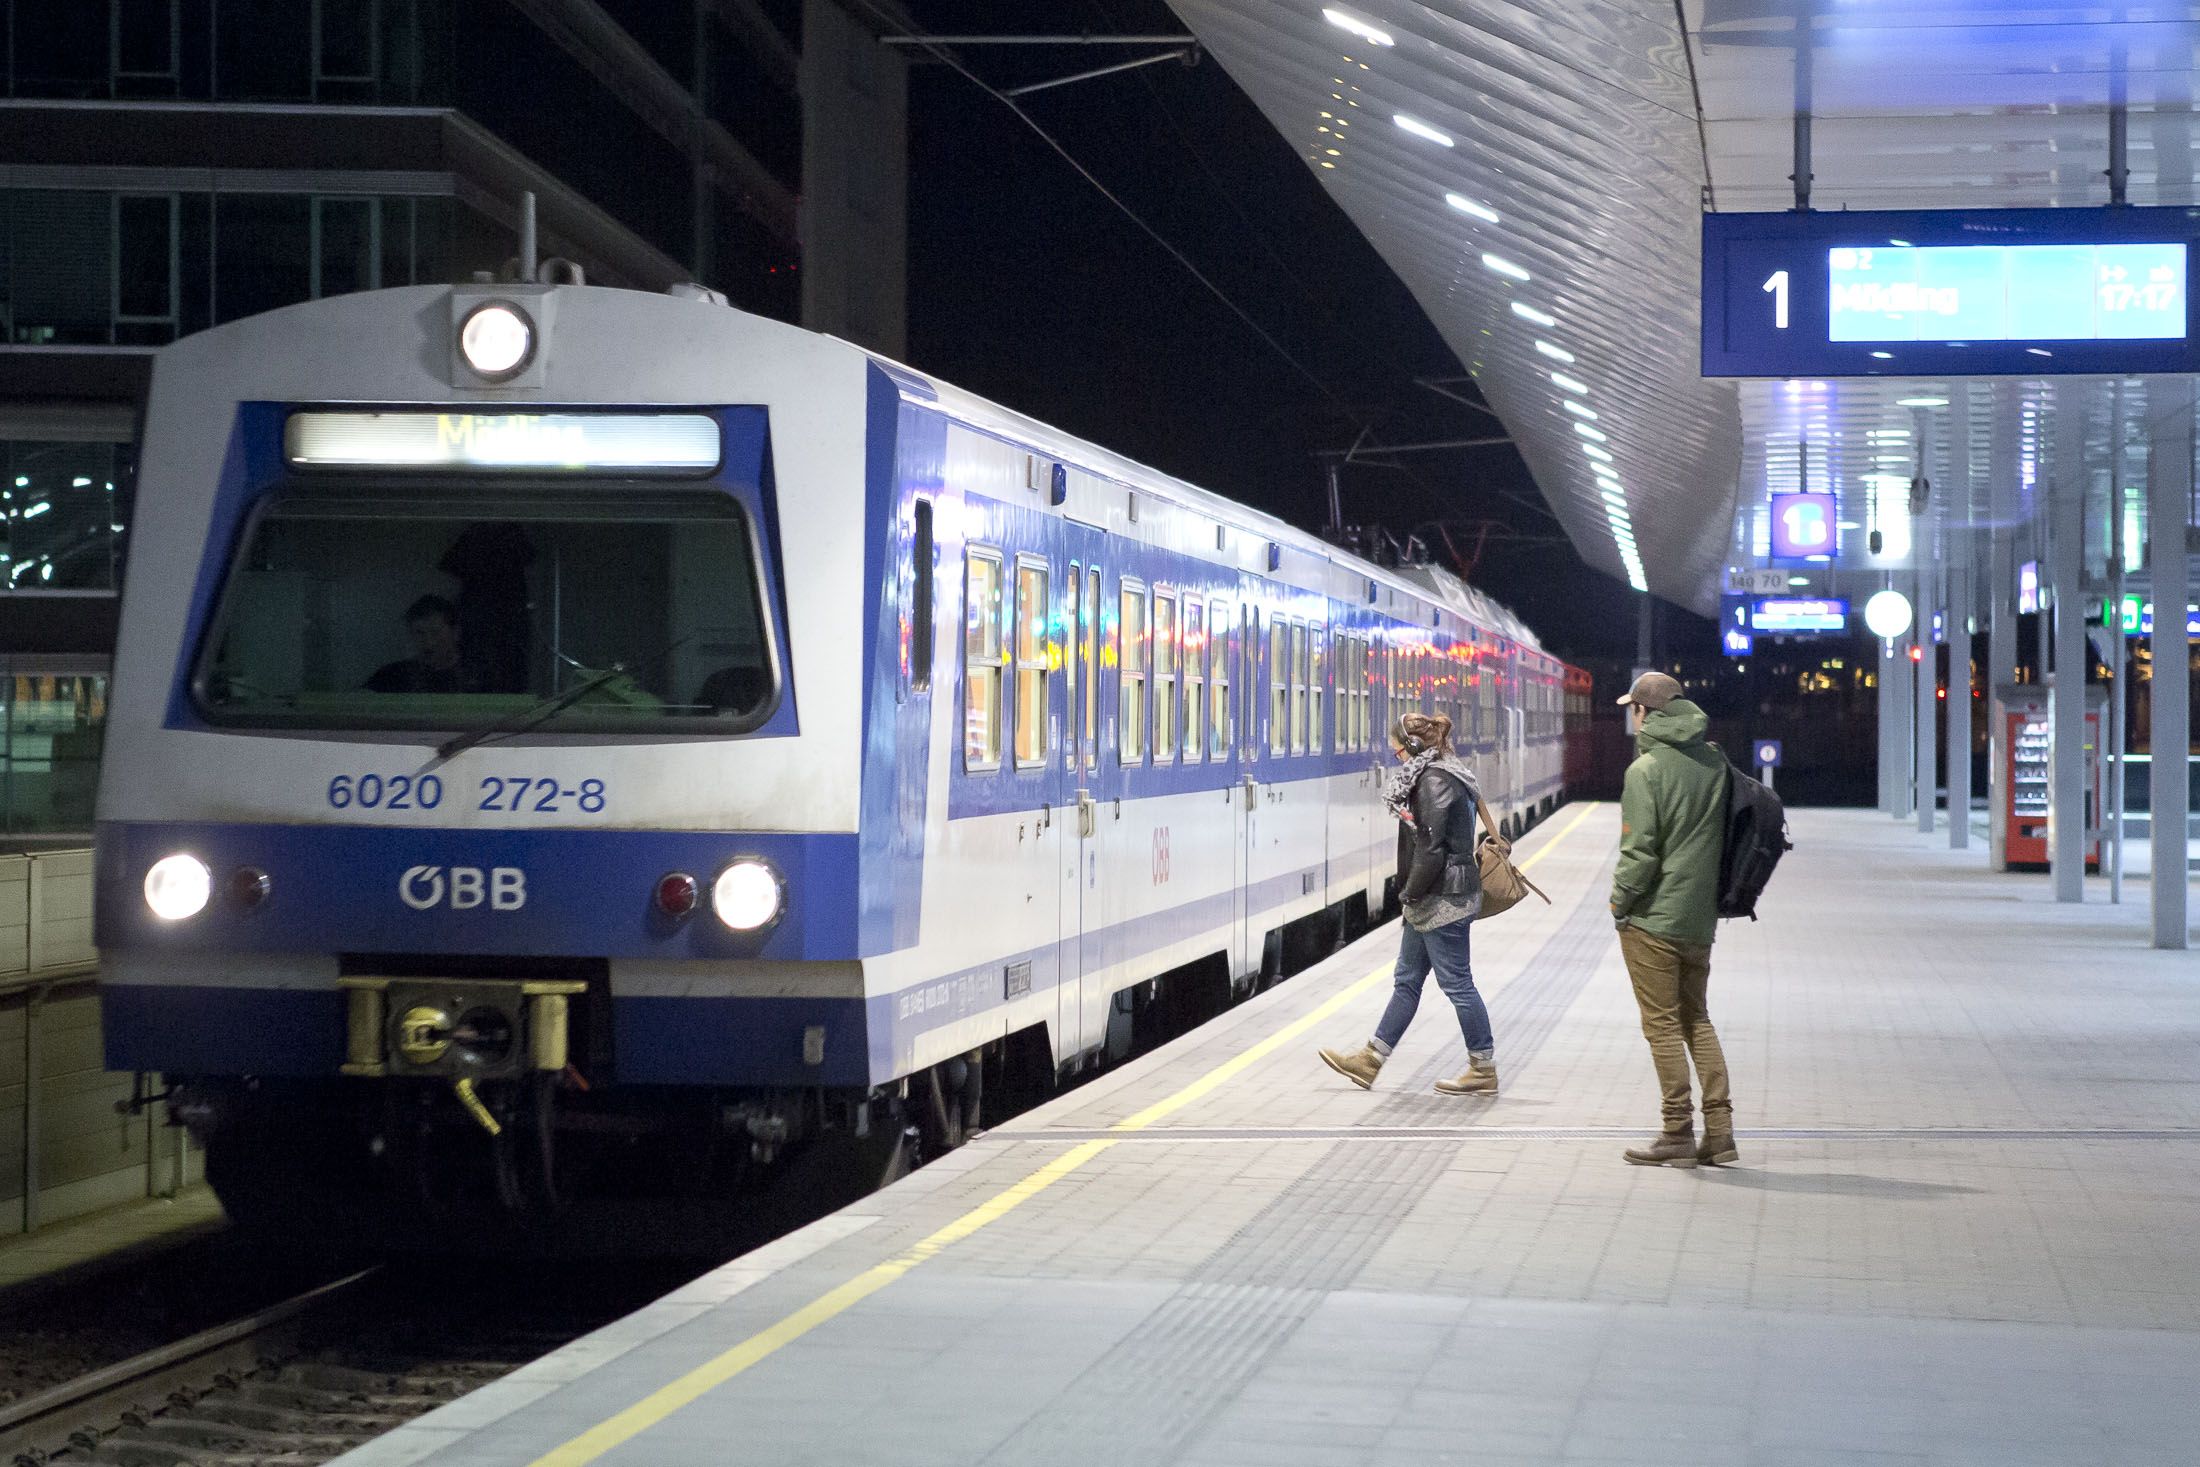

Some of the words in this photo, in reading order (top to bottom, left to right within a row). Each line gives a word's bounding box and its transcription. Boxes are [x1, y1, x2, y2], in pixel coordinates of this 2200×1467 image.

[1762, 271, 1789, 329] 1
[2100, 283, 2177, 311] 17:17
[327, 773, 443, 809] 6020
[478, 776, 607, 813] 272-8
[399, 864, 527, 911] ÖBB
